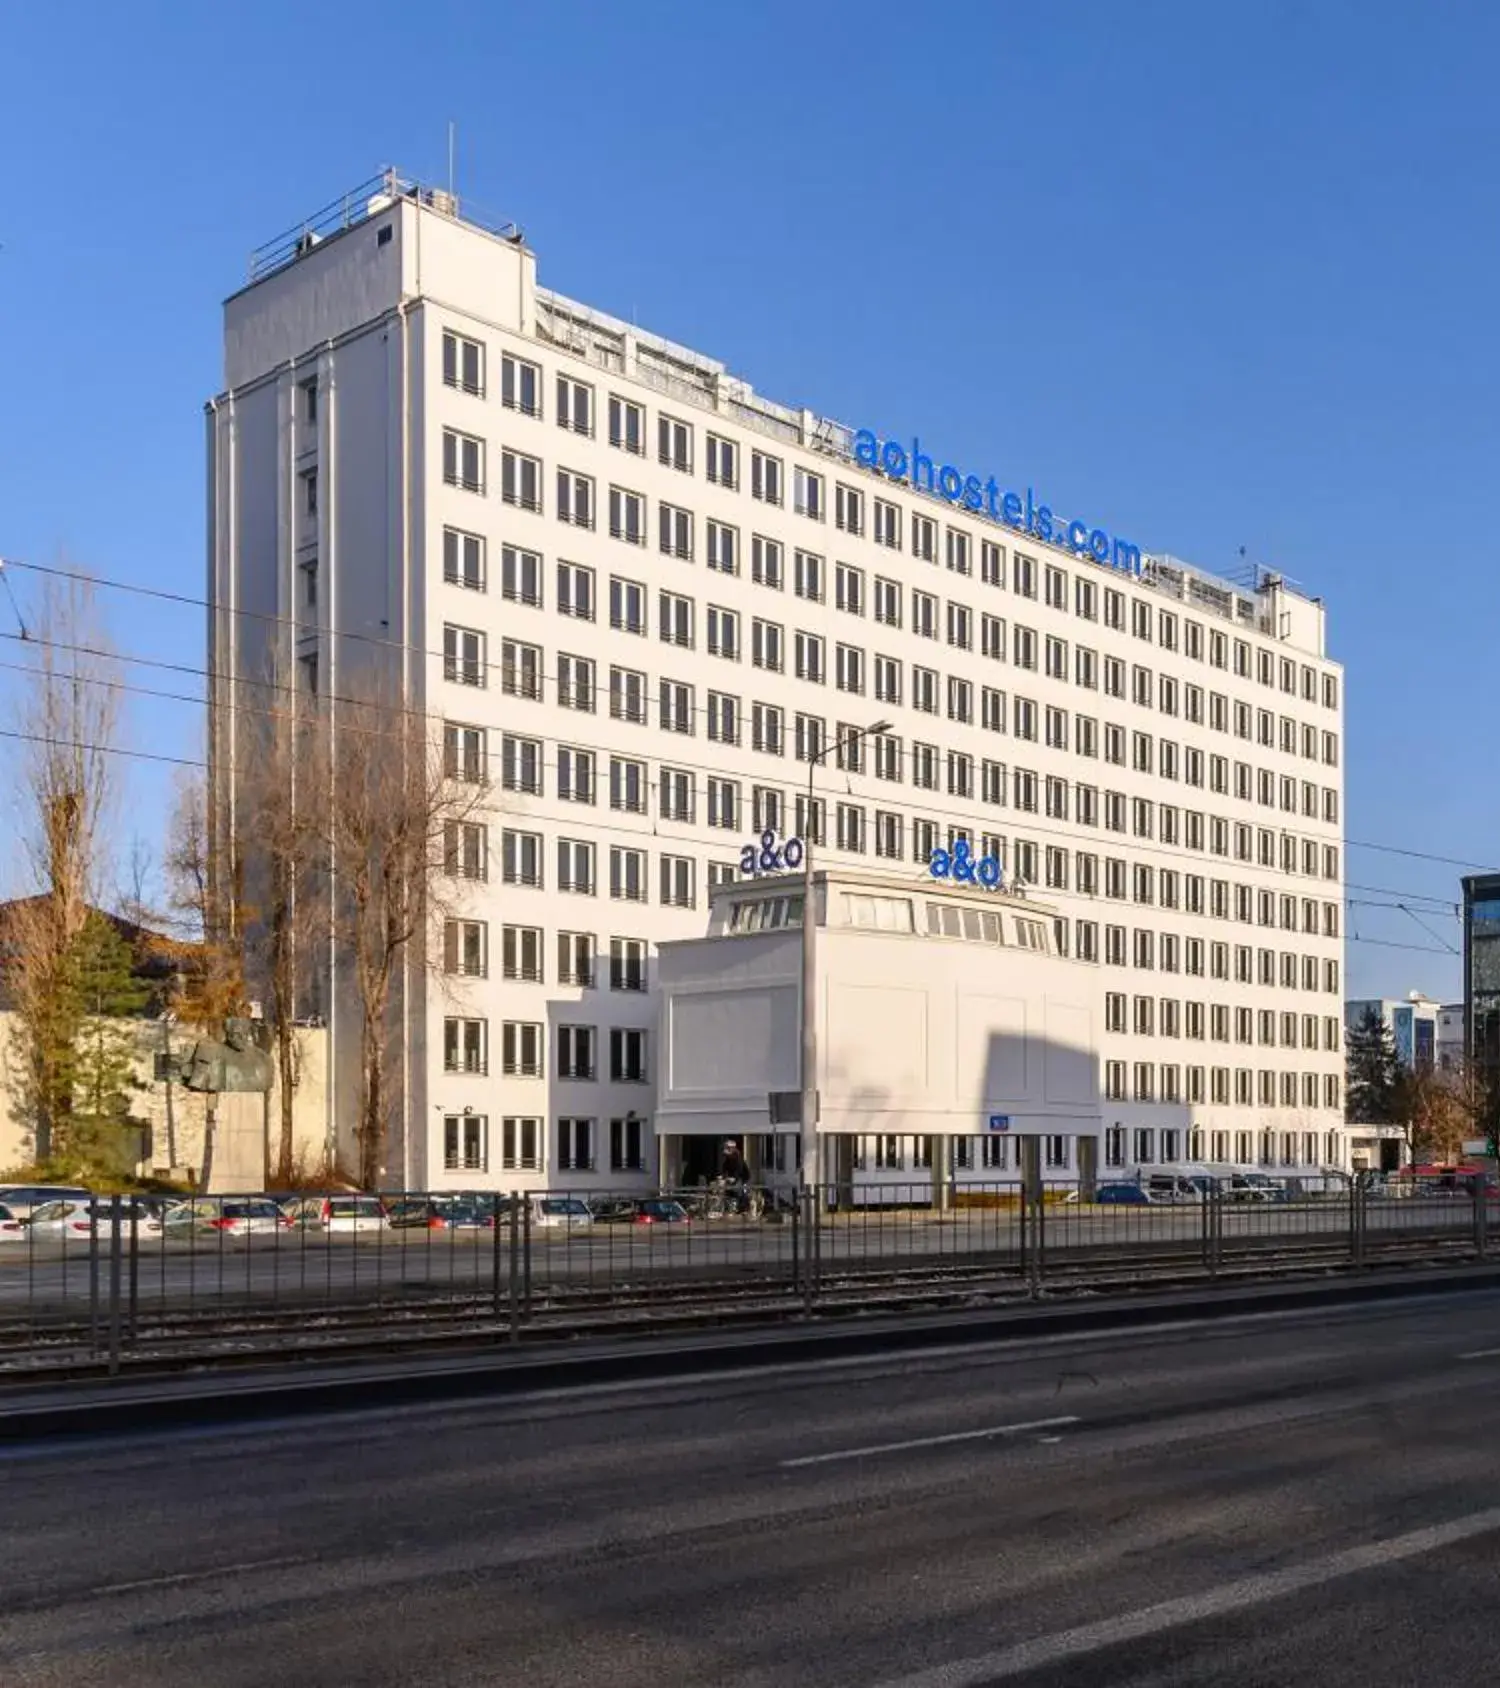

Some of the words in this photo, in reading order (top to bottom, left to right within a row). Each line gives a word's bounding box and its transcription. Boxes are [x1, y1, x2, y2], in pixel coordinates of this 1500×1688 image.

[854, 428, 1141, 576] aohostels.com
[740, 829, 803, 874] a&o
[929, 836, 1001, 886] a&o
